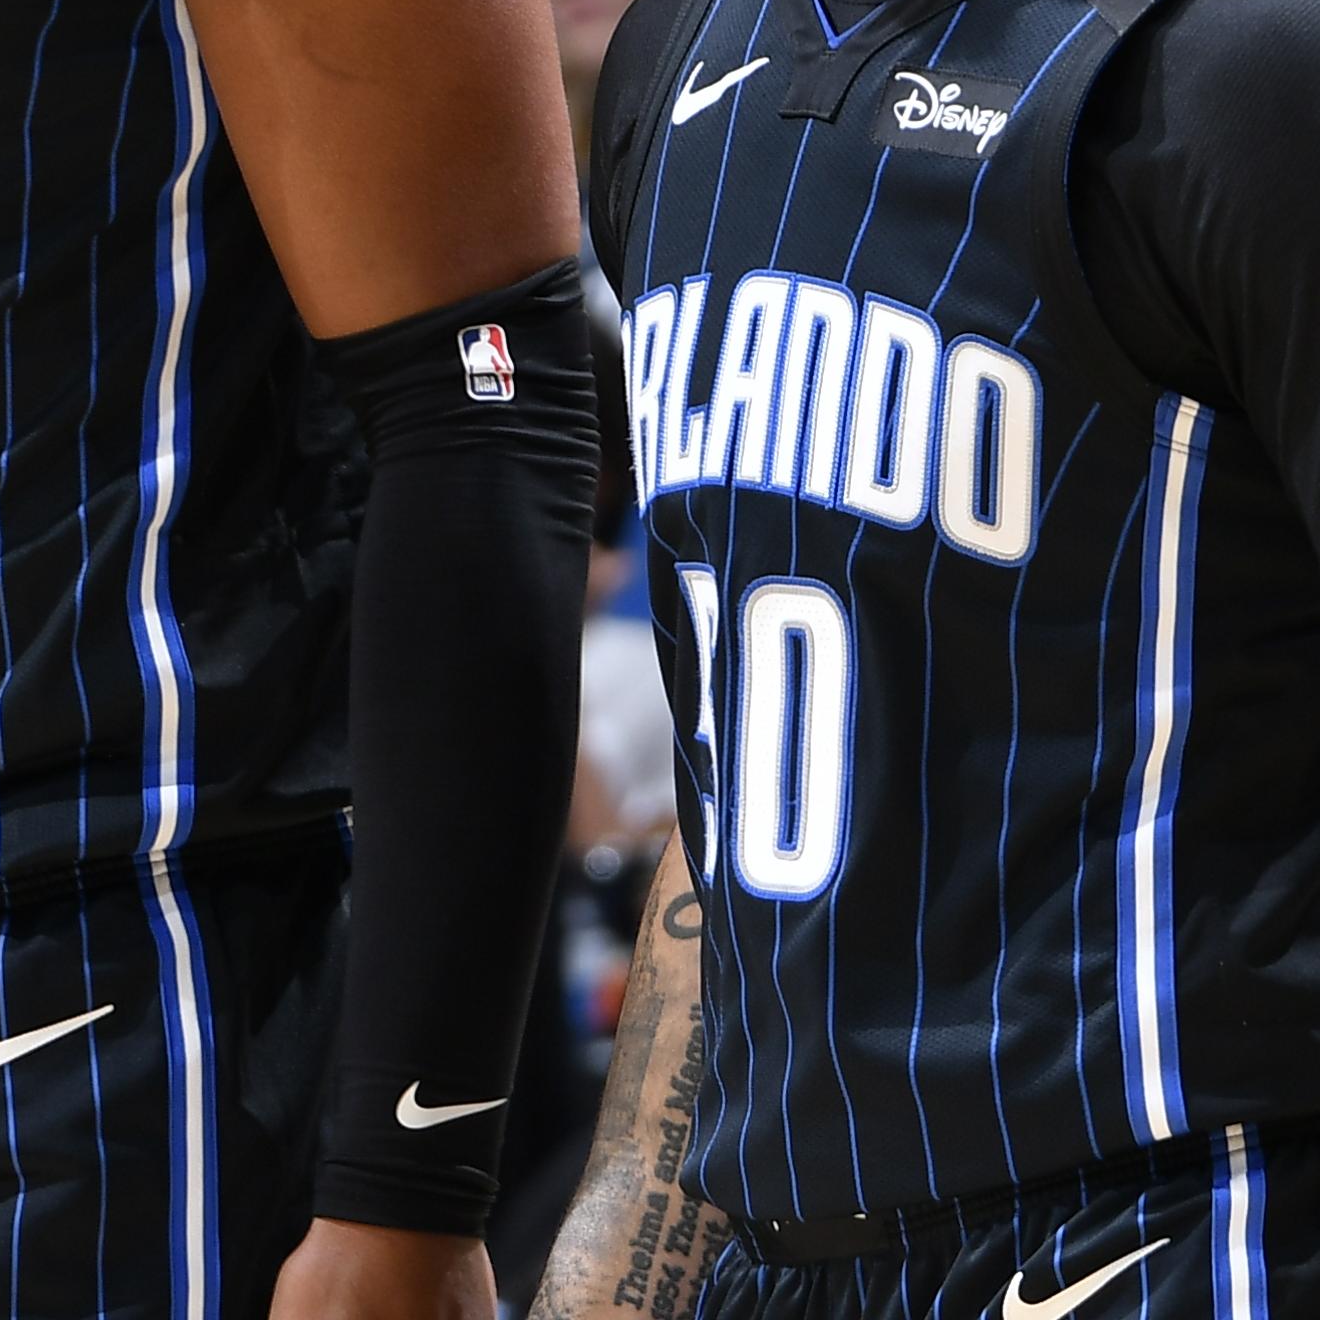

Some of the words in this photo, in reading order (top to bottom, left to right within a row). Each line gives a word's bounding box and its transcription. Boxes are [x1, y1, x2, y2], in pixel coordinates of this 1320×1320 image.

[473, 375, 500, 393] NBA
[612, 1191, 670, 1311] Thelma
[654, 1119, 689, 1184] and
